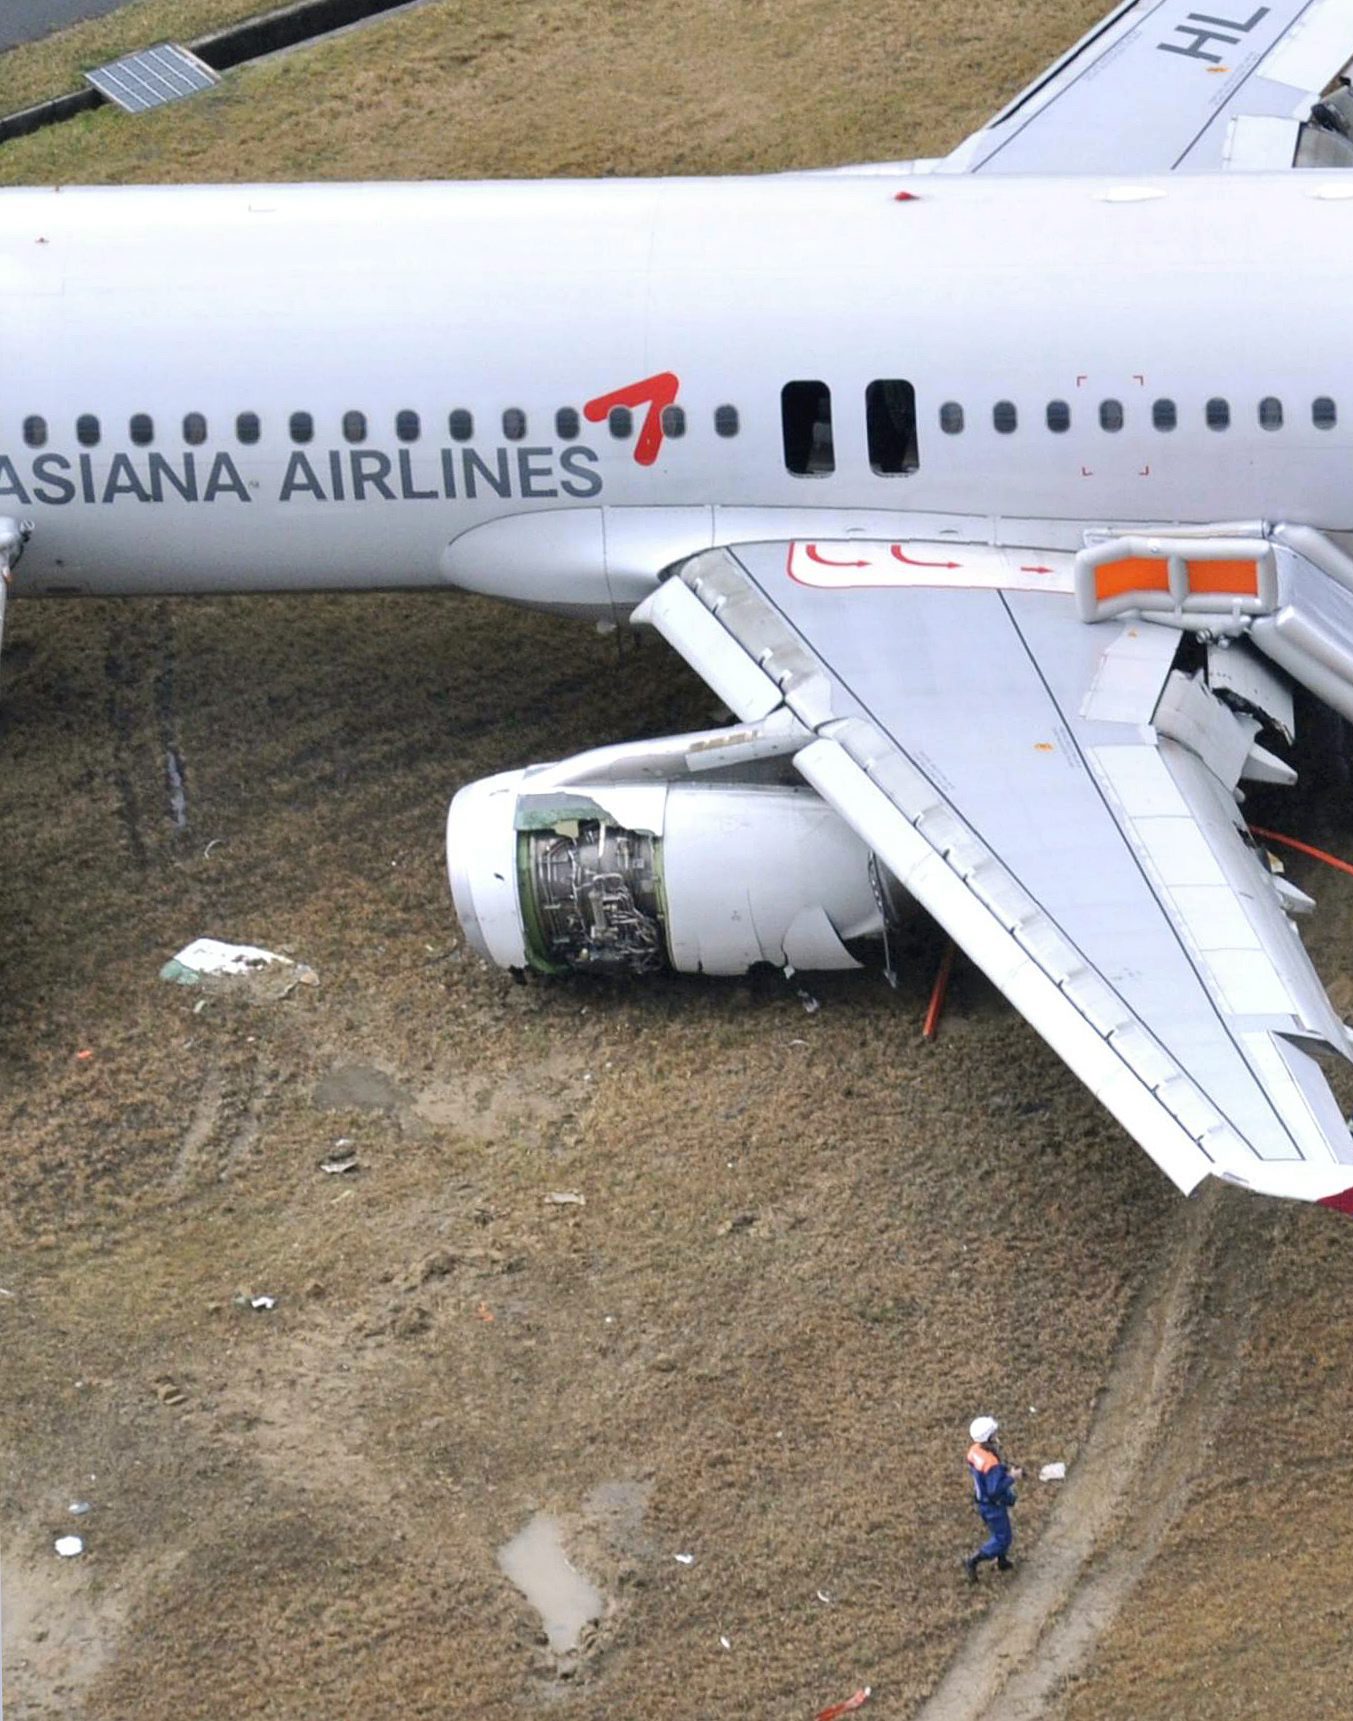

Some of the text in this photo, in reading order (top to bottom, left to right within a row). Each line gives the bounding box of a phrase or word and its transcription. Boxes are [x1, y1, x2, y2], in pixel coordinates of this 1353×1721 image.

[1156, 6, 1272, 64] HL
[0, 445, 604, 506] ASIANA AIRLINES
